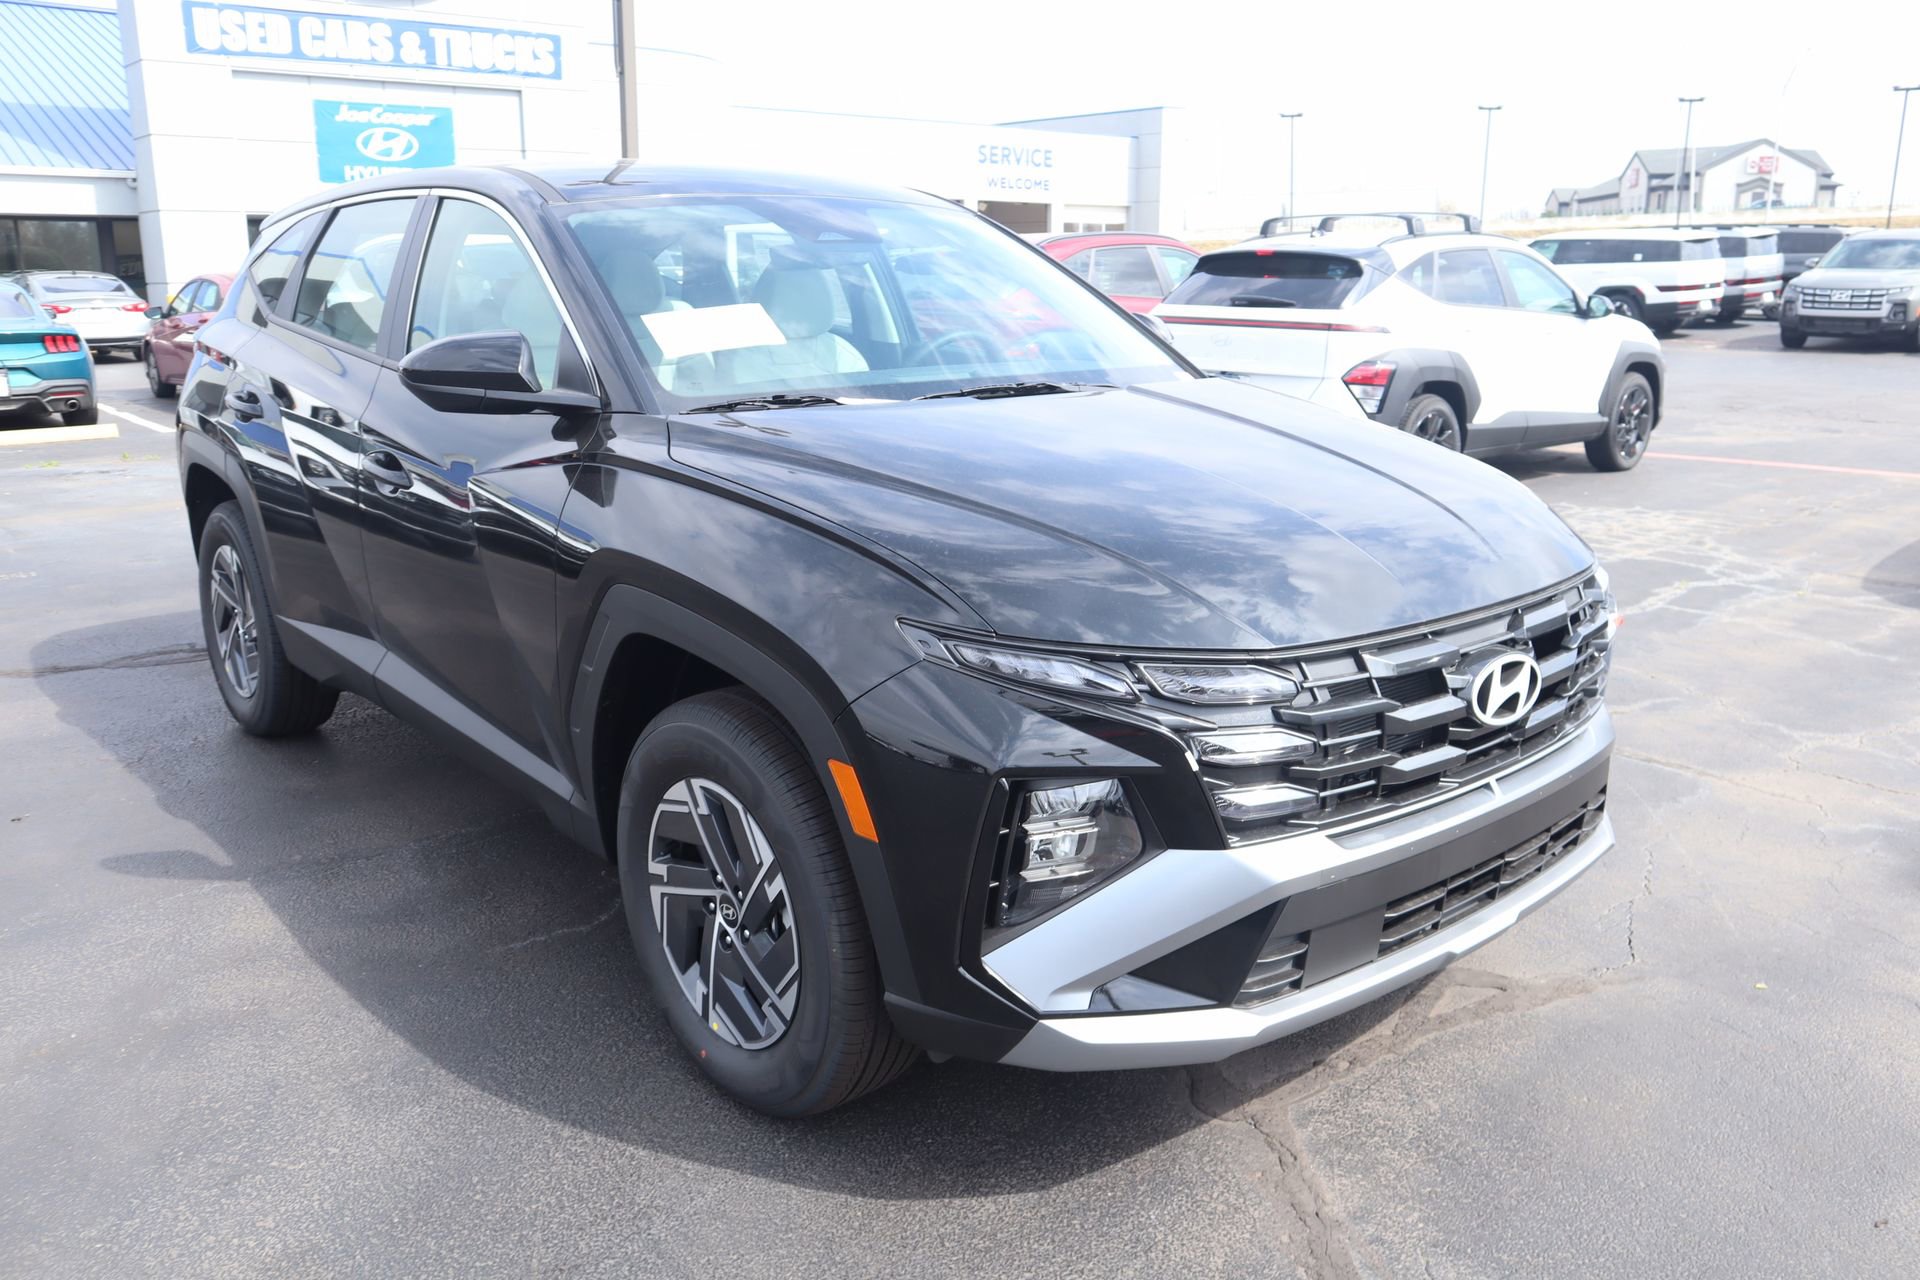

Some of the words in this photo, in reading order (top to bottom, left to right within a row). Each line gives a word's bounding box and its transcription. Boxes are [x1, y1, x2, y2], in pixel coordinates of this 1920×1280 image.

[192, 7, 293, 55] USED
[298, 16, 394, 62] CARS
[400, 31, 426, 64] &
[428, 28, 556, 75] TRUCKS
[978, 145, 1053, 168] SERVICE
[987, 177, 1049, 191] WELCOME
